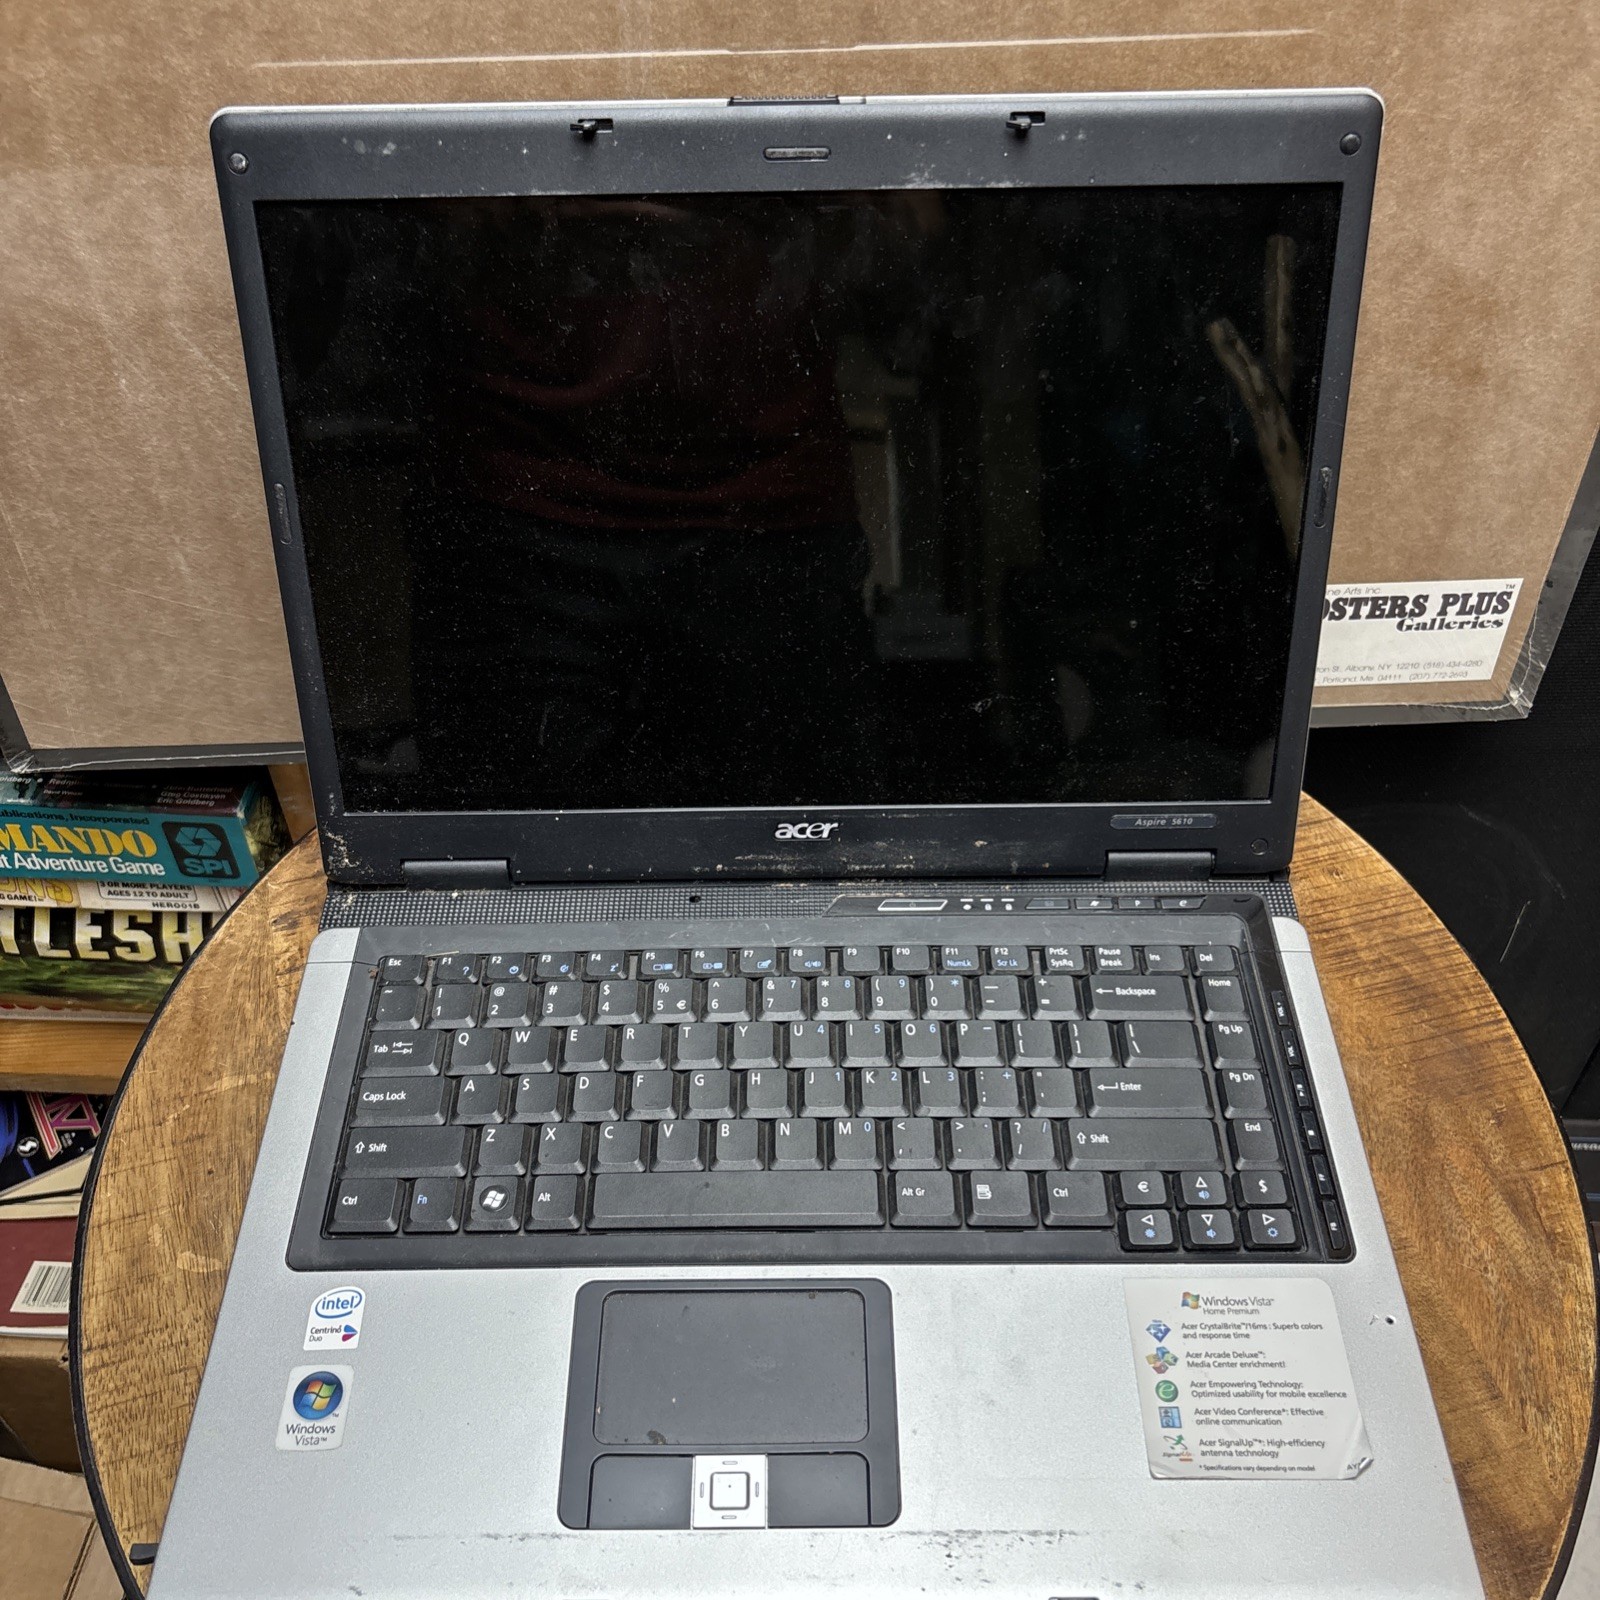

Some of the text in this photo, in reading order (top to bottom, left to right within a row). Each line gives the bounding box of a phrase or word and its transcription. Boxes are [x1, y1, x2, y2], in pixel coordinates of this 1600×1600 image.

[1344, 587, 1361, 595] Arts
[1436, 591, 1513, 617] PLUS
[1396, 616, 1503, 632] Galleries
[1397, 662, 1420, 670] 12210
[1378, 674, 1401, 682] 04111
[175, 798, 215, 806] Goldberg
[1135, 817, 1193, 827] Aspire 5610
[775, 822, 839, 839] acer
[14, 853, 166, 876] Adventure Game
[183, 858, 234, 875] SPI
[645, 952, 655, 960] F5
[744, 950, 754, 958] F7
[793, 949, 803, 957] F8
[847, 948, 857, 956] F9
[1049, 947, 1068, 955] PrtSc
[1099, 948, 1121, 956] Pause
[388, 958, 402, 966] Esc
[491, 956, 502, 964] F2
[997, 959, 1018, 967] Scr Lk
[1051, 958, 1073, 968] SysRq
[1101, 958, 1122, 967] Break
[1200, 954, 1213, 962] Del
[947, 959, 972, 968] NumLk
[1208, 979, 1231, 987] Home
[1115, 987, 1156, 996] Backspace
[626, 1028, 635, 1040] R
[683, 1027, 691, 1038] T
[739, 1026, 748, 1037] Y
[794, 1025, 803, 1036] U
[1218, 1024, 1243, 1034] Pg Up
[458, 1032, 470, 1045] Q
[515, 1031, 531, 1043] W
[570, 1030, 578, 1041] E
[374, 1045, 388, 1053] Tab
[637, 1076, 644, 1087] F
[694, 1074, 705, 1086] G
[751, 1074, 761, 1085] H
[1229, 1072, 1254, 1083] Pg Dn
[464, 1080, 475, 1092] A
[522, 1078, 530, 1090] S
[579, 1077, 589, 1089] D
[1120, 1082, 1141, 1090] Enter
[363, 1091, 406, 1101] Caps Lock
[605, 1126, 613, 1139] C
[663, 1124, 674, 1136] V
[721, 1124, 730, 1136] B
[780, 1123, 790, 1136] N
[838, 1123, 851, 1134] M
[1245, 1123, 1261, 1132] End
[486, 1129, 495, 1141] Z
[545, 1128, 556, 1141] X
[1090, 1133, 1109, 1143] Shift
[368, 1143, 387, 1152] Shift
[902, 1187, 925, 1197] Alt Gr
[1053, 1187, 1068, 1198] Ctrl
[342, 1196, 358, 1205] Ctrl
[417, 1195, 427, 1204] Fn
[538, 1193, 551, 1202] Alt
[322, 1295, 354, 1310] intel
[1201, 1296, 1248, 1306] Windows
[1272, 1322, 1299, 1331] Superb
[1190, 1380, 1303, 1390] Acer Empowering Technology:
[1191, 1390, 1231, 1398] Optimized
[1233, 1390, 1264, 1399] usability
[1266, 1390, 1277, 1398] for
[1291, 1408, 1324, 1416] Effective
[1222, 1418, 1282, 1426] communication
[286, 1424, 336, 1435] Windows
[1199, 1438, 1216, 1446] Acer
[1267, 1439, 1325, 1448] High-efficiency
[1235, 1449, 1279, 1458] technology
